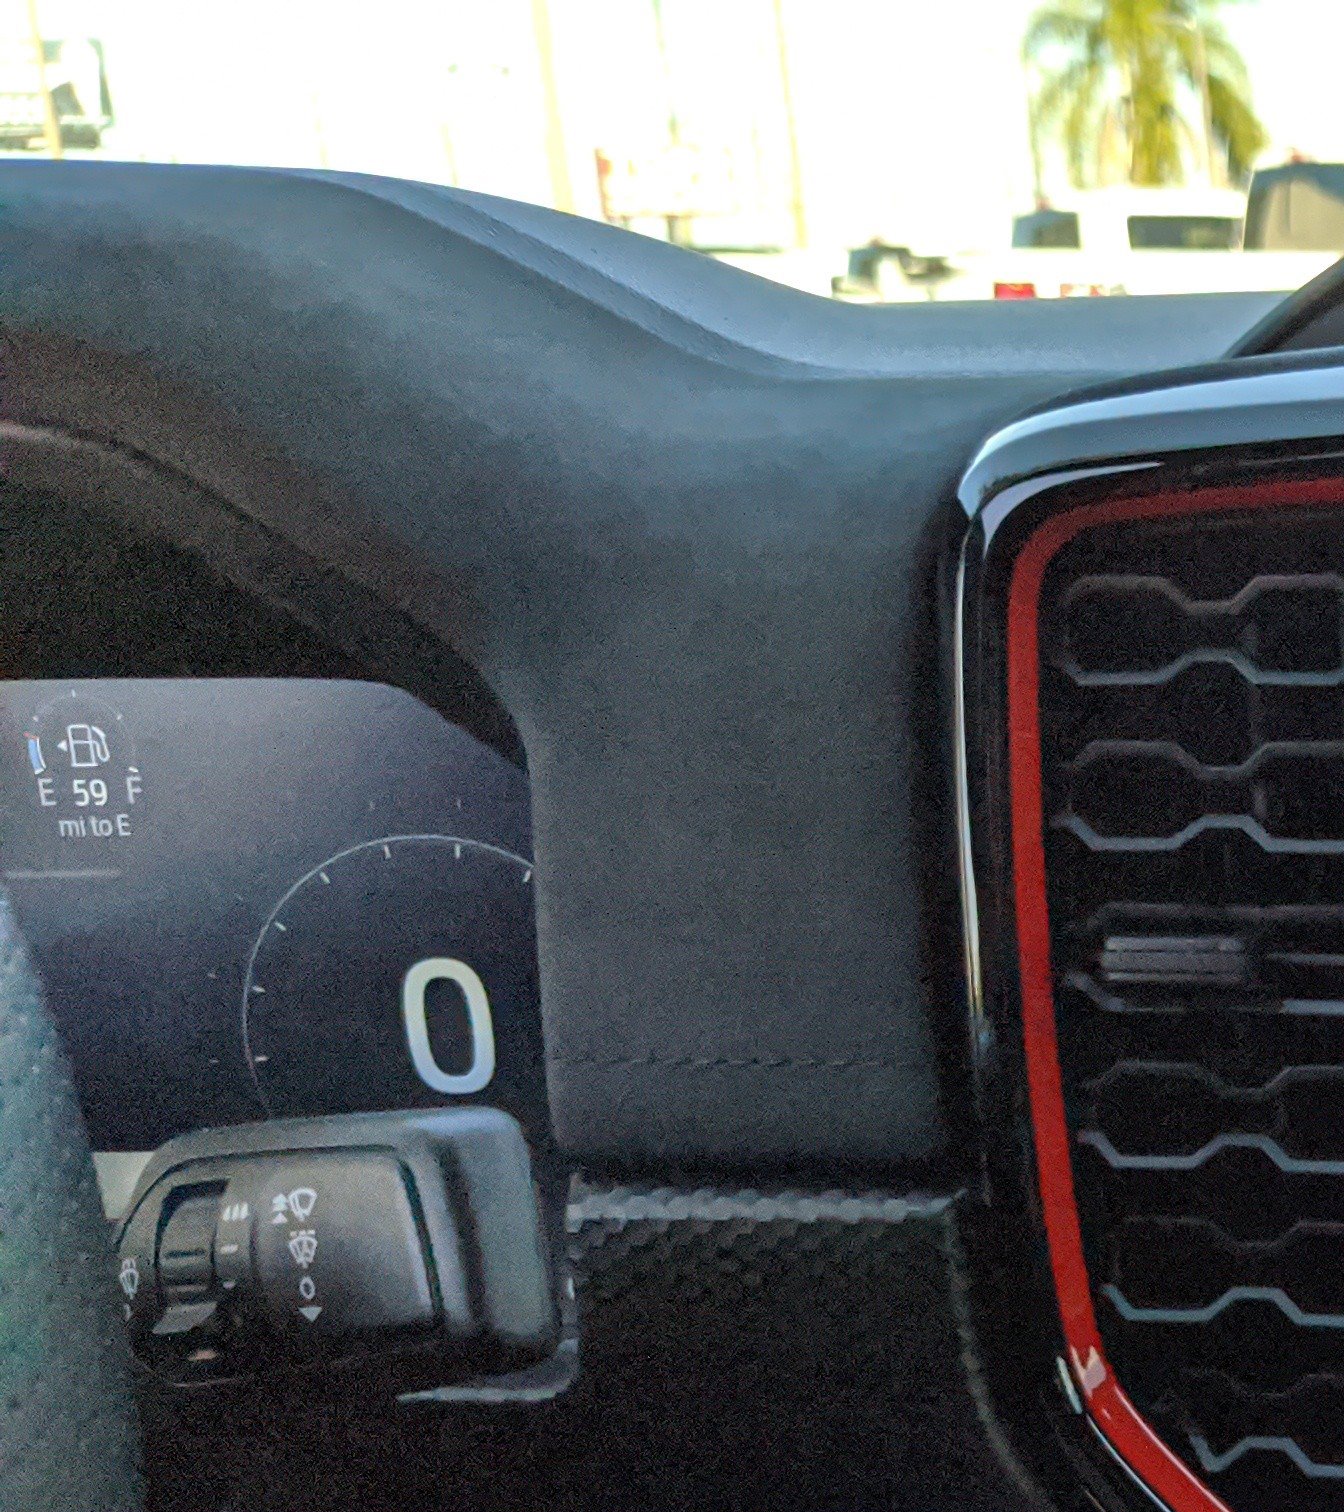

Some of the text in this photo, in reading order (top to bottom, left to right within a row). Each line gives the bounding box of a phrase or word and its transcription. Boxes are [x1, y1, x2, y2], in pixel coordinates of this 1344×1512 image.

[38, 776, 143, 806] E 59 F
[403, 957, 497, 1094] 0
